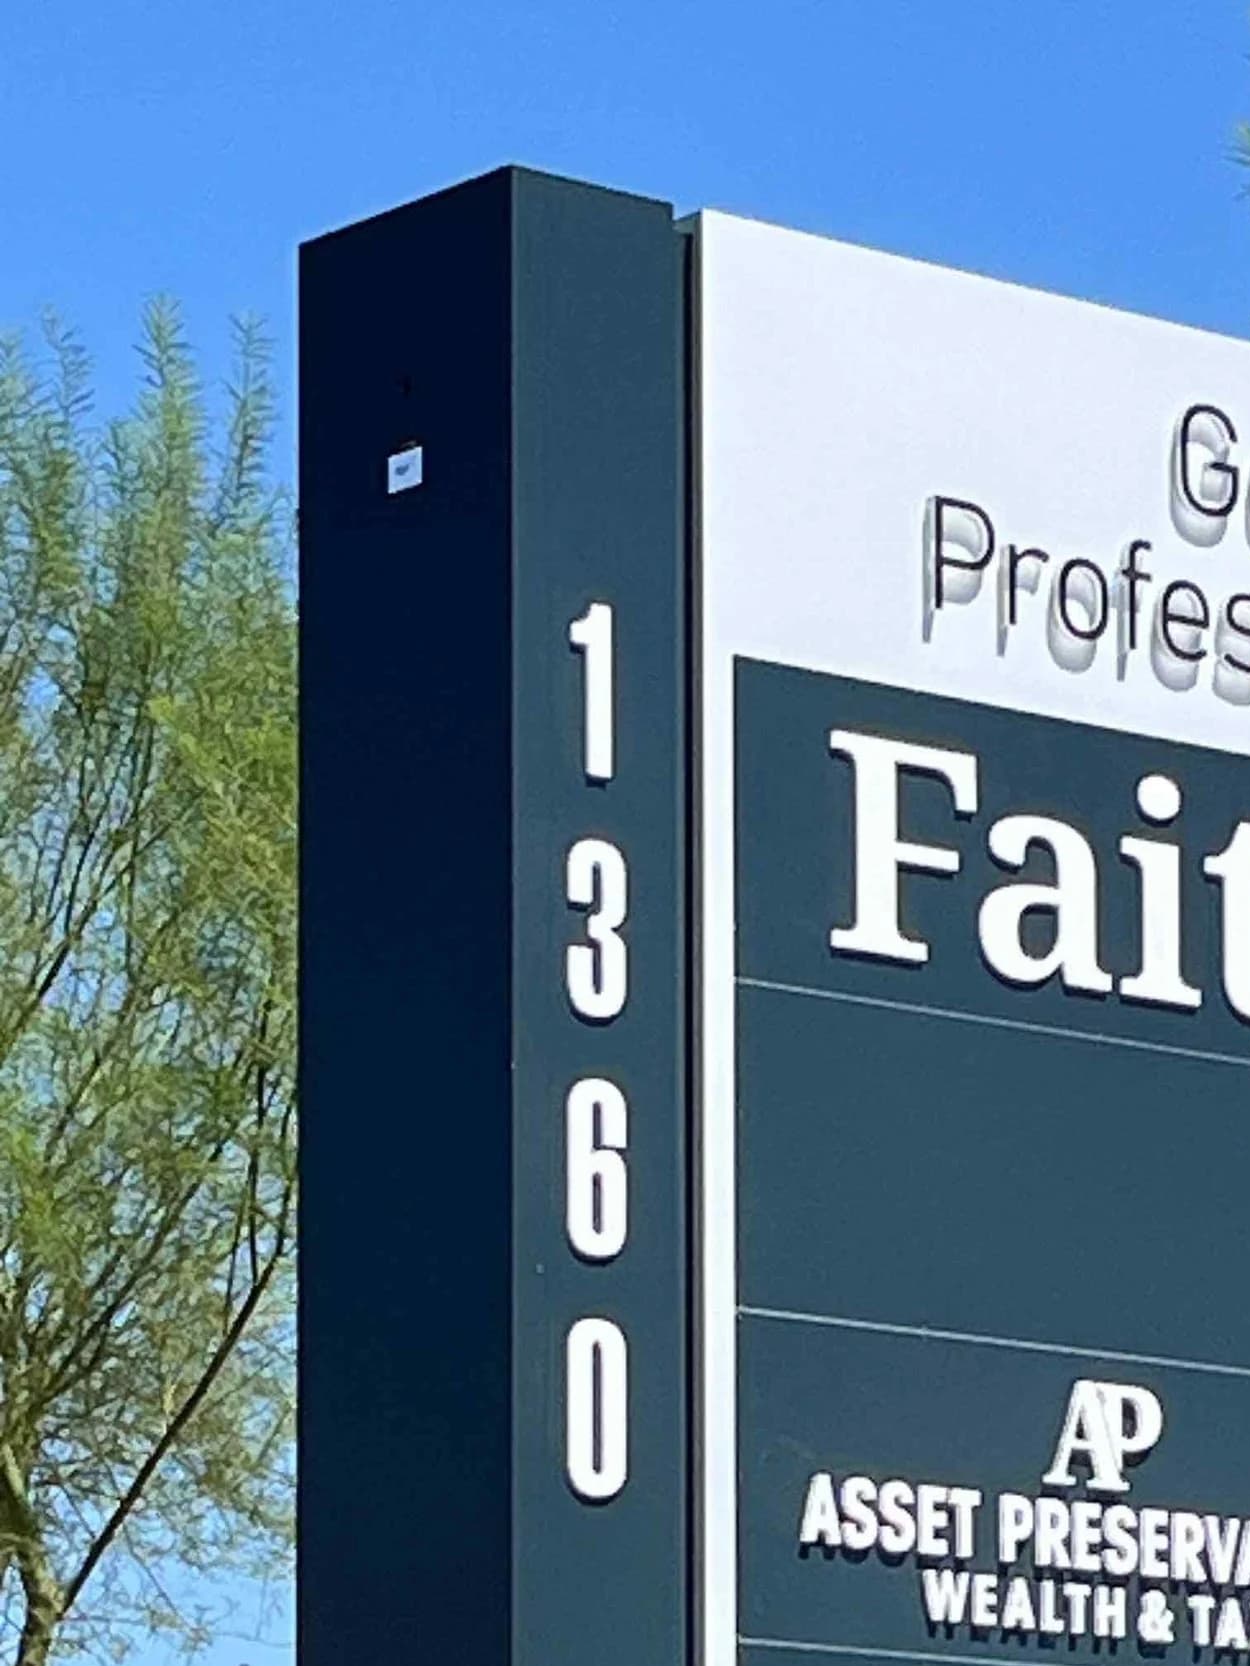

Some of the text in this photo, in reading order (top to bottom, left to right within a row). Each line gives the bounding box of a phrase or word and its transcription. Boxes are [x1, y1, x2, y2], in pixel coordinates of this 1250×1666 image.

[566, 602, 628, 1500] 1360
[1042, 1378, 1163, 1492] AP
[800, 1472, 982, 1559] ASSET
[922, 1568, 1127, 1641] WEALTH
[1137, 1589, 1175, 1644] &
